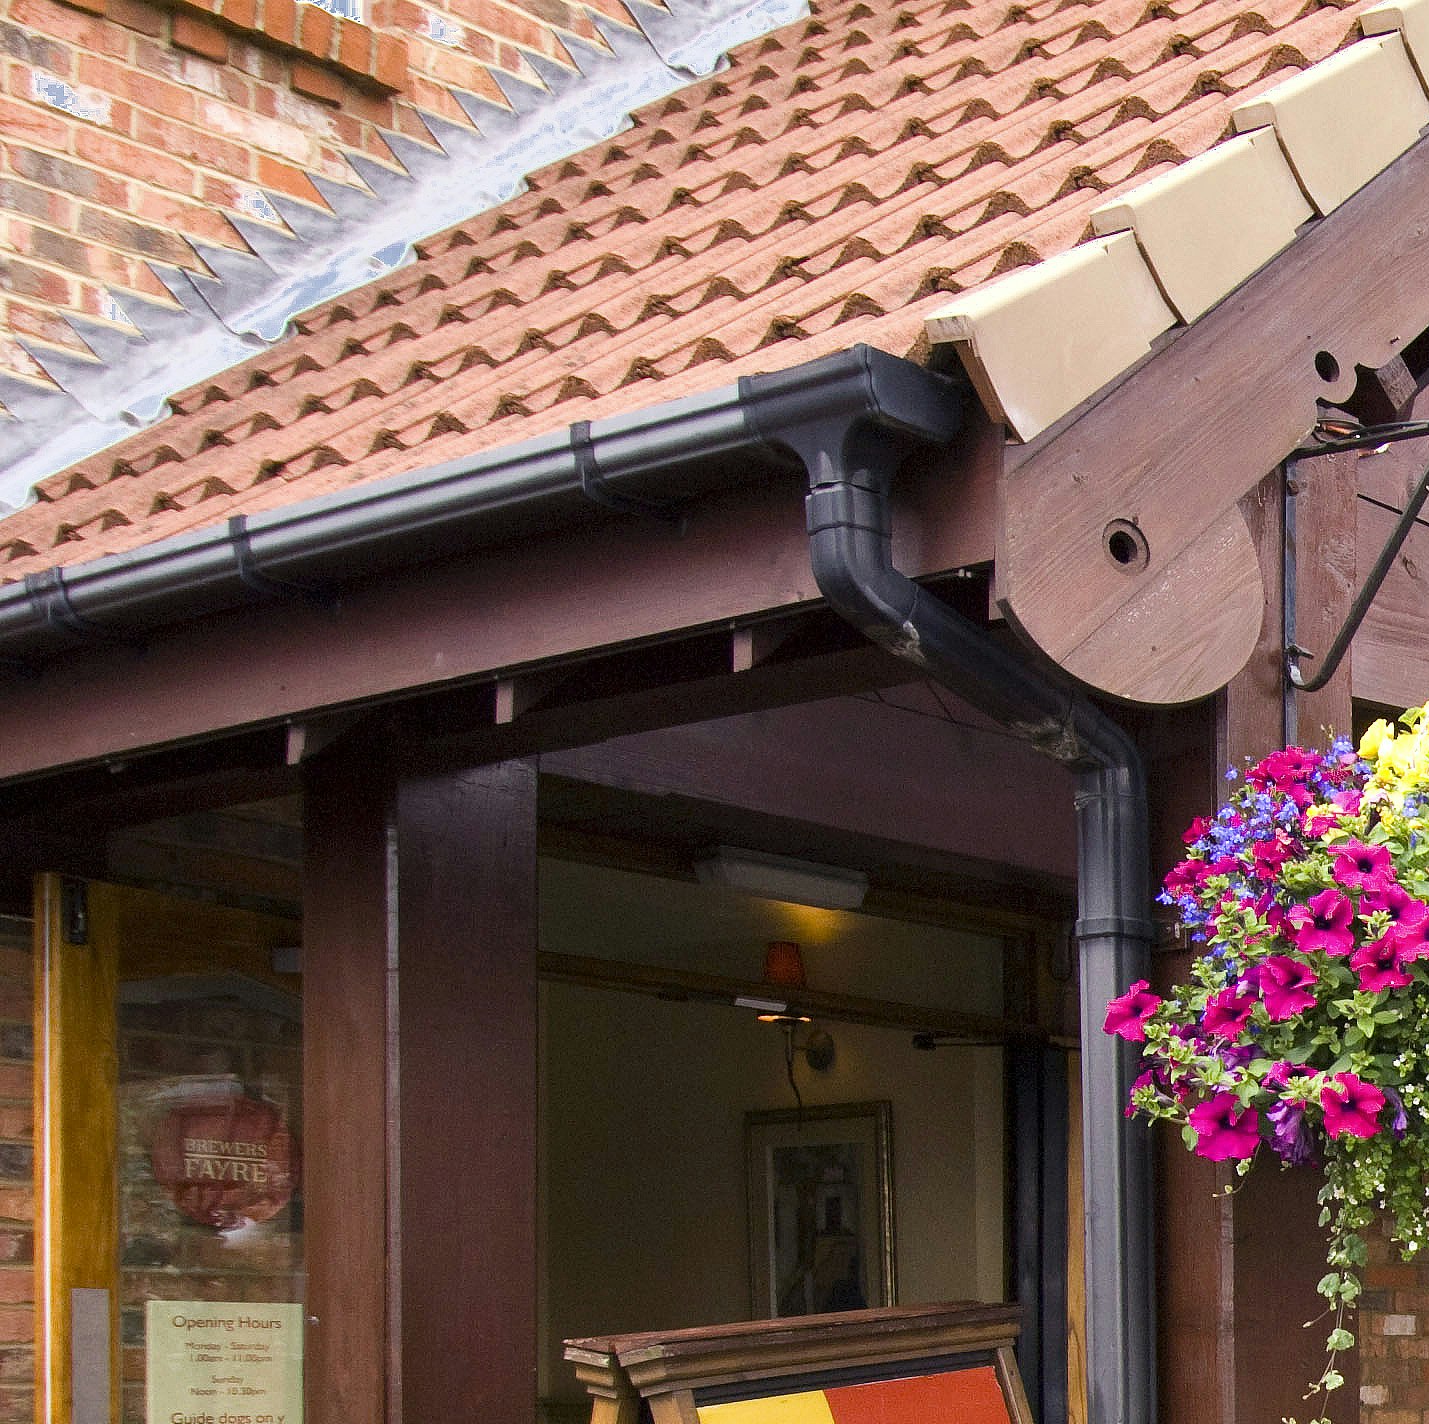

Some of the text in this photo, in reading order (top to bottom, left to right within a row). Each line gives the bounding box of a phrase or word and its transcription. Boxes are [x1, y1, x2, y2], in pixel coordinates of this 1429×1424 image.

[183, 1137, 268, 1157] BREWERS
[183, 1158, 268, 1183] FAYRE
[172, 1315, 282, 1332] Opening Hours
[184, 1342, 221, 1351] Monday
[230, 1341, 270, 1353] Saturday
[211, 1375, 244, 1385] Sunday
[190, 1387, 217, 1396] Noon
[171, 1411, 215, 1424] Guide
